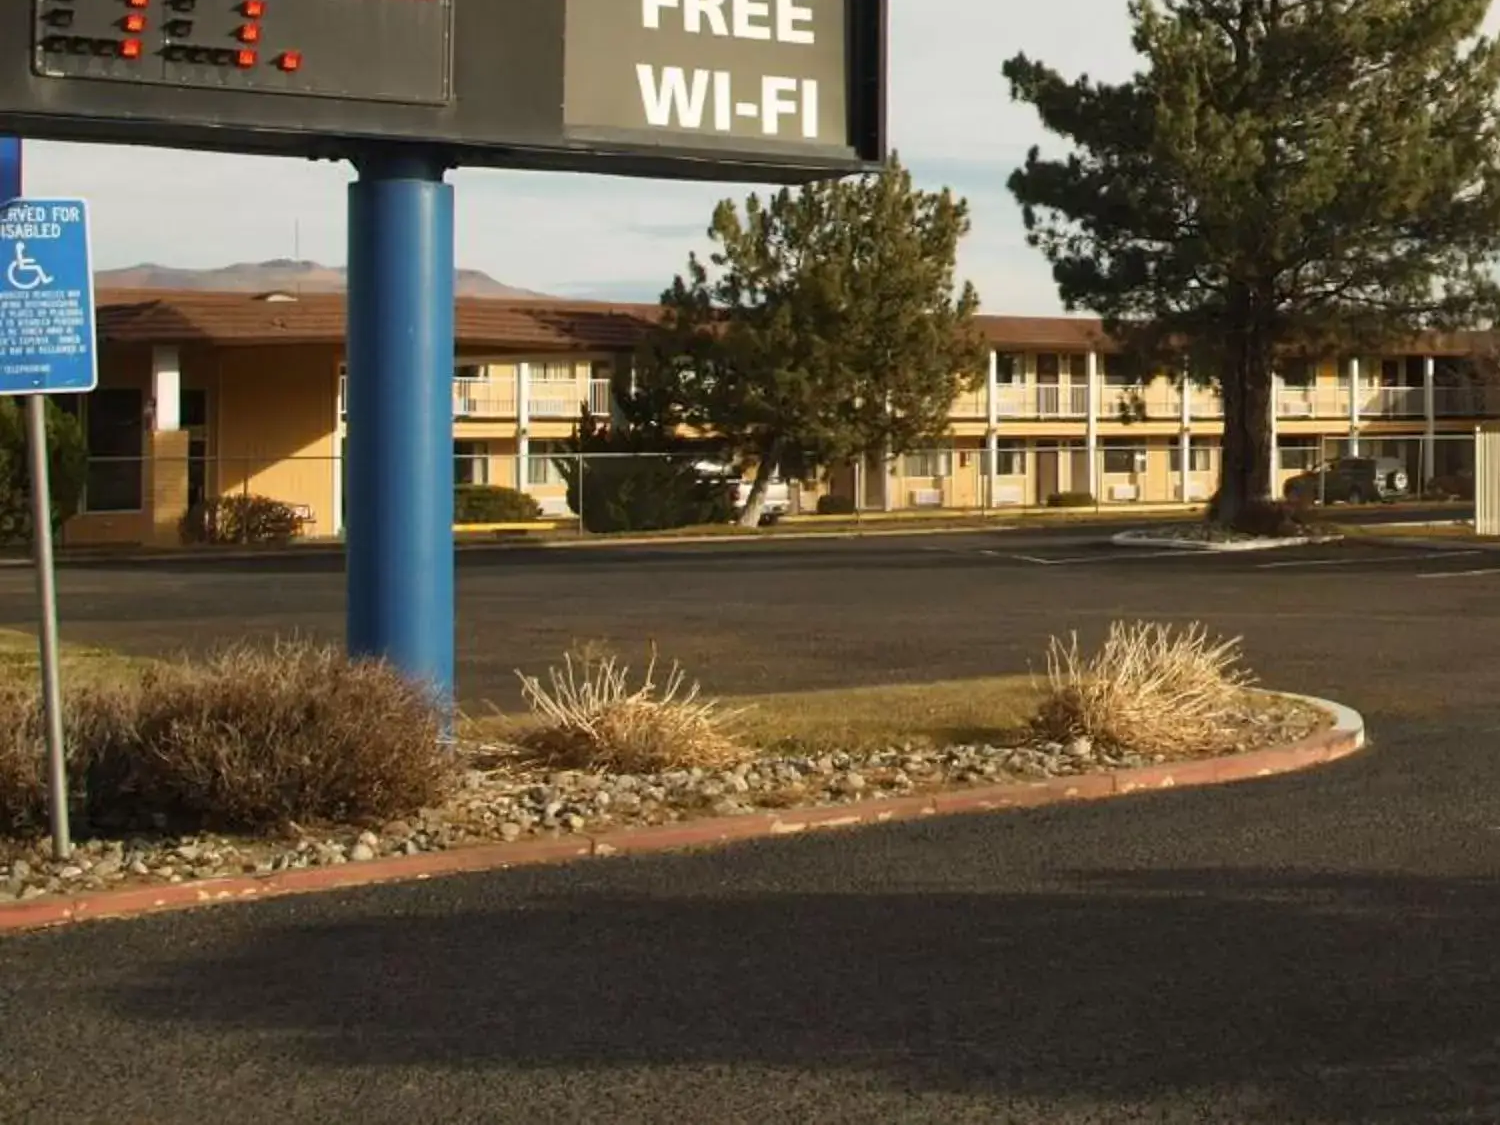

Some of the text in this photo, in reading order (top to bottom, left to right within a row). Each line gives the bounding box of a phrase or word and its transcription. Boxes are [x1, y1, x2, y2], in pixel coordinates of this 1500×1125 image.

[635, 63, 818, 138] WI-FI
[1, 206, 81, 223] RVED FOR
